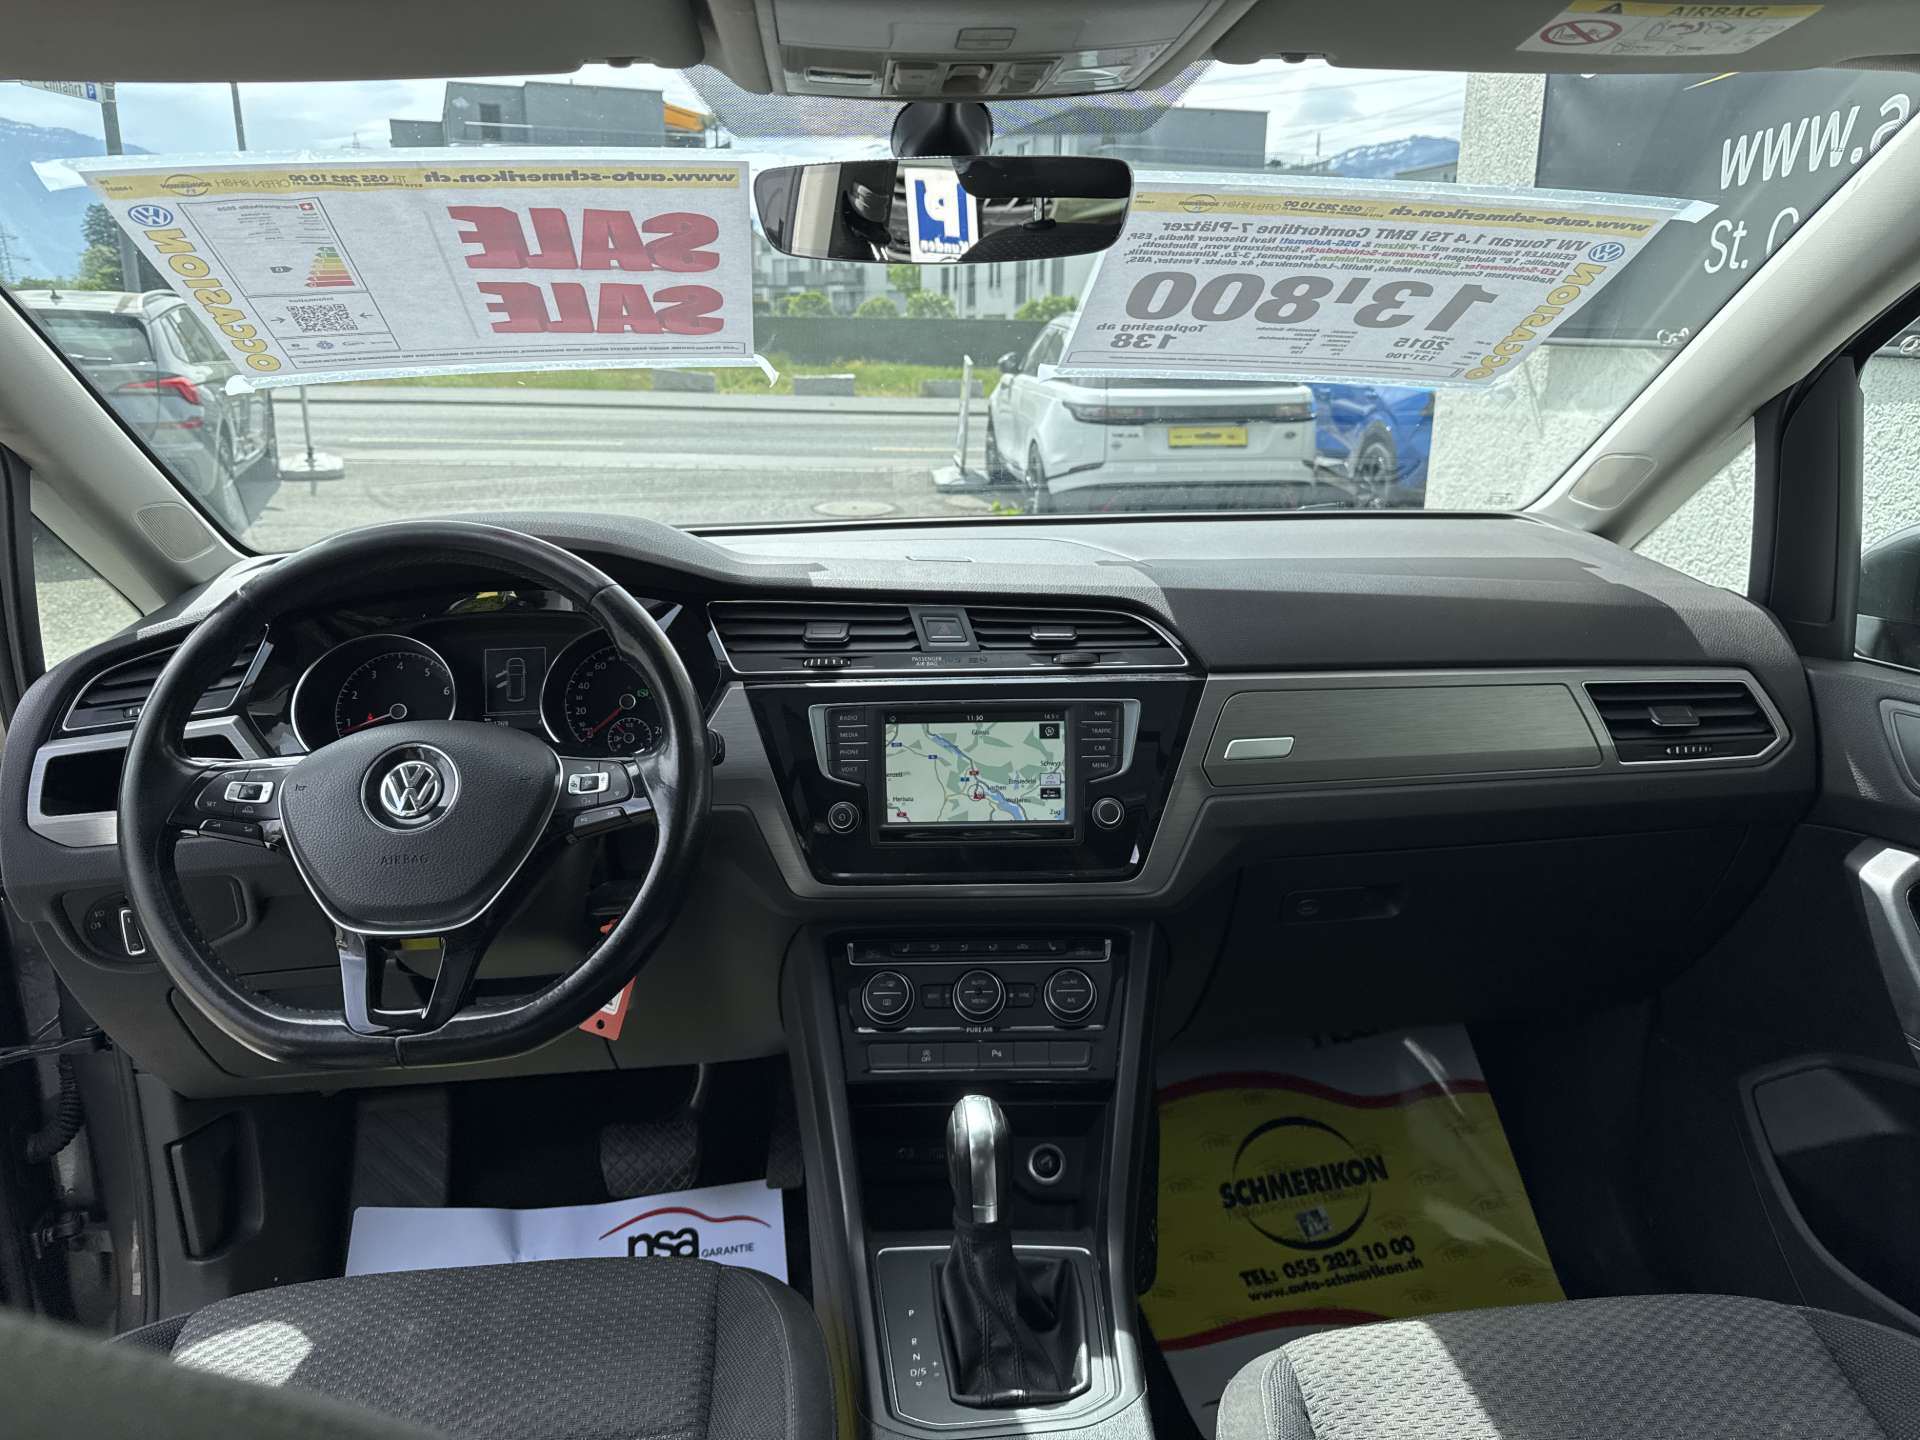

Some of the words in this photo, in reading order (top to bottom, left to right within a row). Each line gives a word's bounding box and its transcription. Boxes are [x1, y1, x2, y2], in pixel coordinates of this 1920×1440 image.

[1667, 6, 1768, 17] AIRBAG
[1704, 219, 1749, 274] St.
[380, 854, 429, 865] AIRBAG
[1219, 1154, 1389, 1210] SCHMERIKON
[628, 1227, 699, 1258] nsa
[701, 1241, 755, 1258] GARANTIE
[1239, 1267, 1280, 1288] TEL:
[1282, 1258, 1321, 1280] 055
[1322, 1248, 1362, 1273] 282
[1362, 1241, 1388, 1263] 10
[1389, 1235, 1416, 1256] 00
[1247, 1256, 1424, 1302] www.auto-schmerikon.ch
[908, 1309, 915, 1317] P
[911, 1337, 918, 1346] R
[912, 1352, 921, 1361] N
